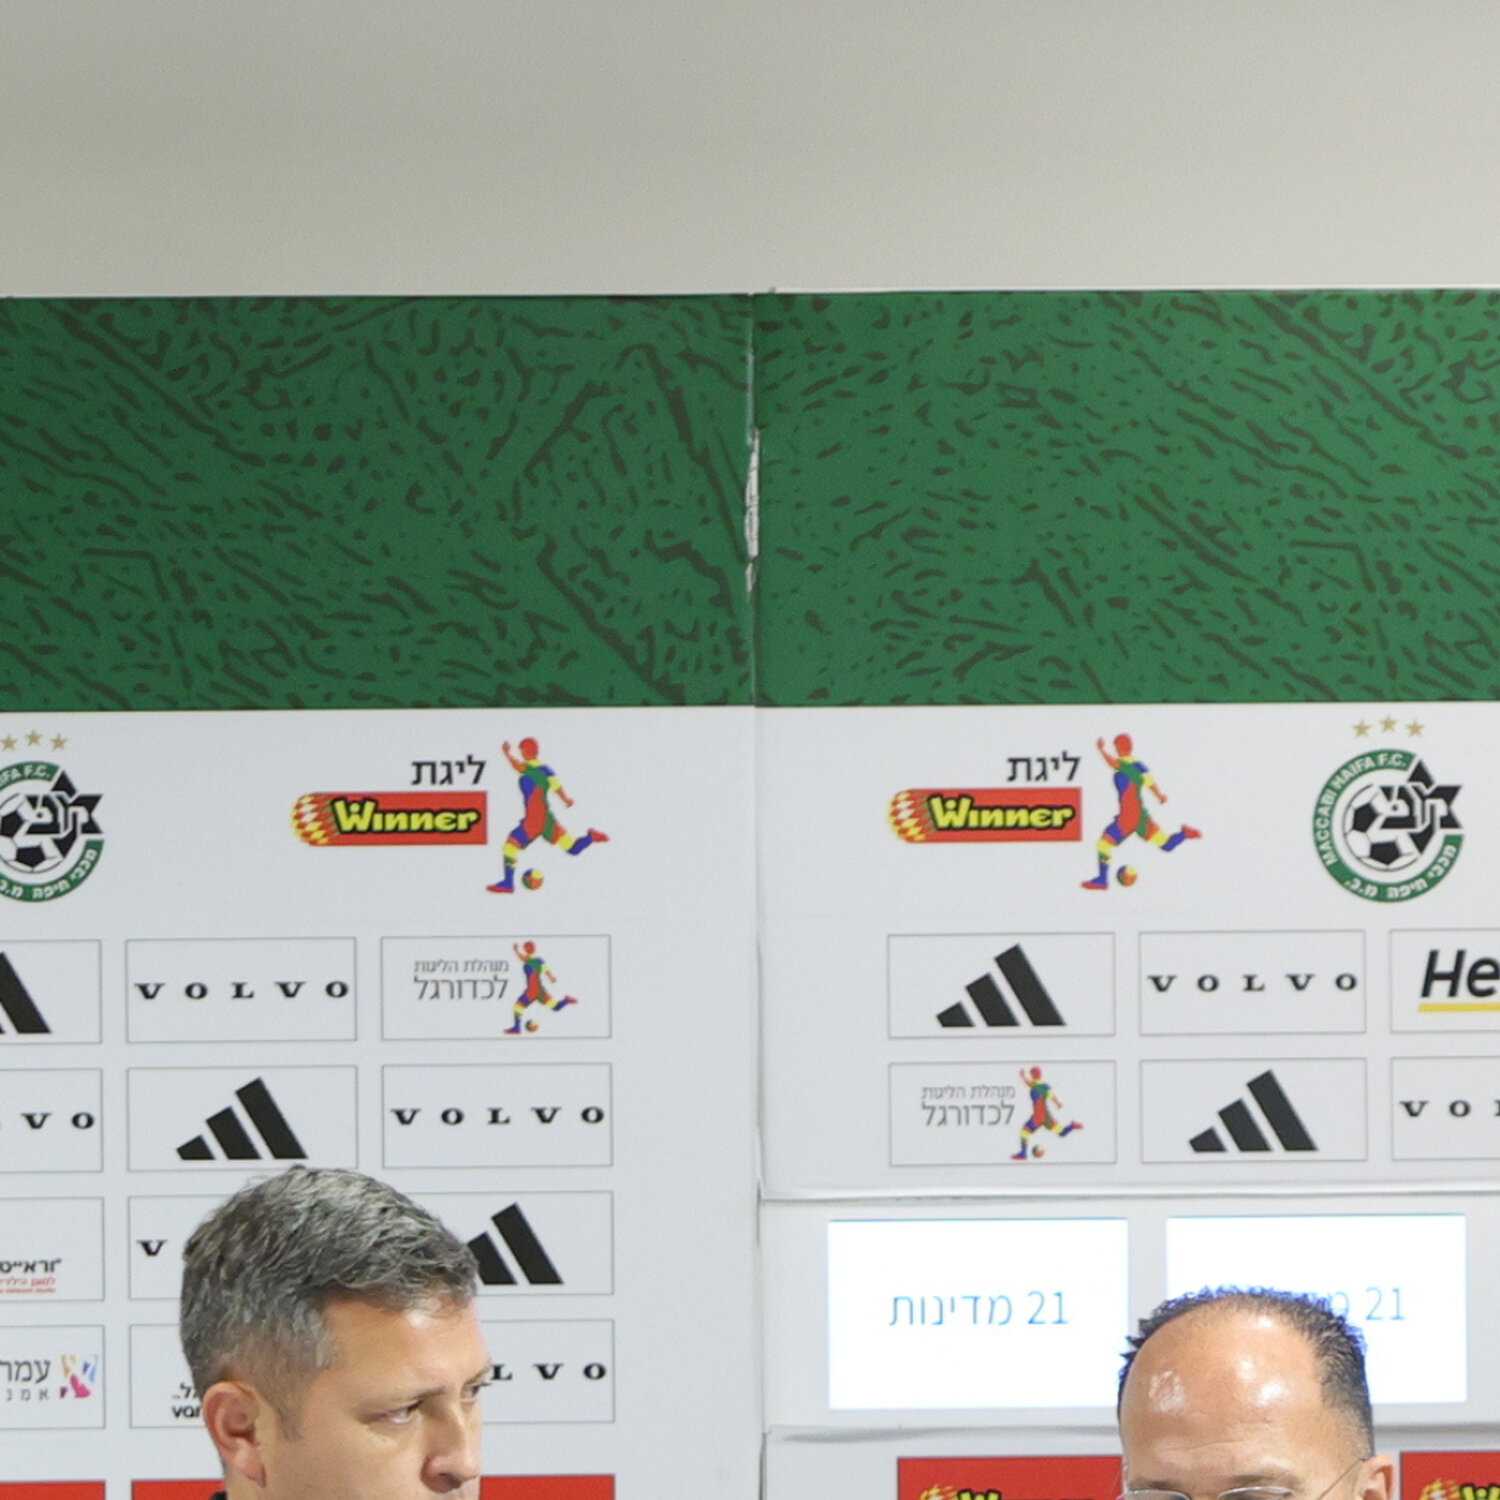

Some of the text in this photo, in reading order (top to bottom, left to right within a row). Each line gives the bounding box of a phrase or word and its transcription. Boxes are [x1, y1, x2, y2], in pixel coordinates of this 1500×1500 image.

[411, 754, 486, 787] ליגת
[1007, 751, 1080, 783] ליגת
[332, 798, 480, 833] Winner
[928, 796, 1076, 830] Winner
[134, 980, 349, 1001] VOLVO
[413, 974, 509, 1001] לכדורגל
[1147, 973, 1358, 993] VOLVO
[390, 1106, 605, 1127] VOLVO
[920, 1100, 1016, 1127] לכדורגל
[888, 1291, 1069, 1327] 21 מדינות
[1364, 1286, 1406, 1321] 21
[0, 1360, 51, 1384] עמר
[491, 1362, 607, 1381] LVO
